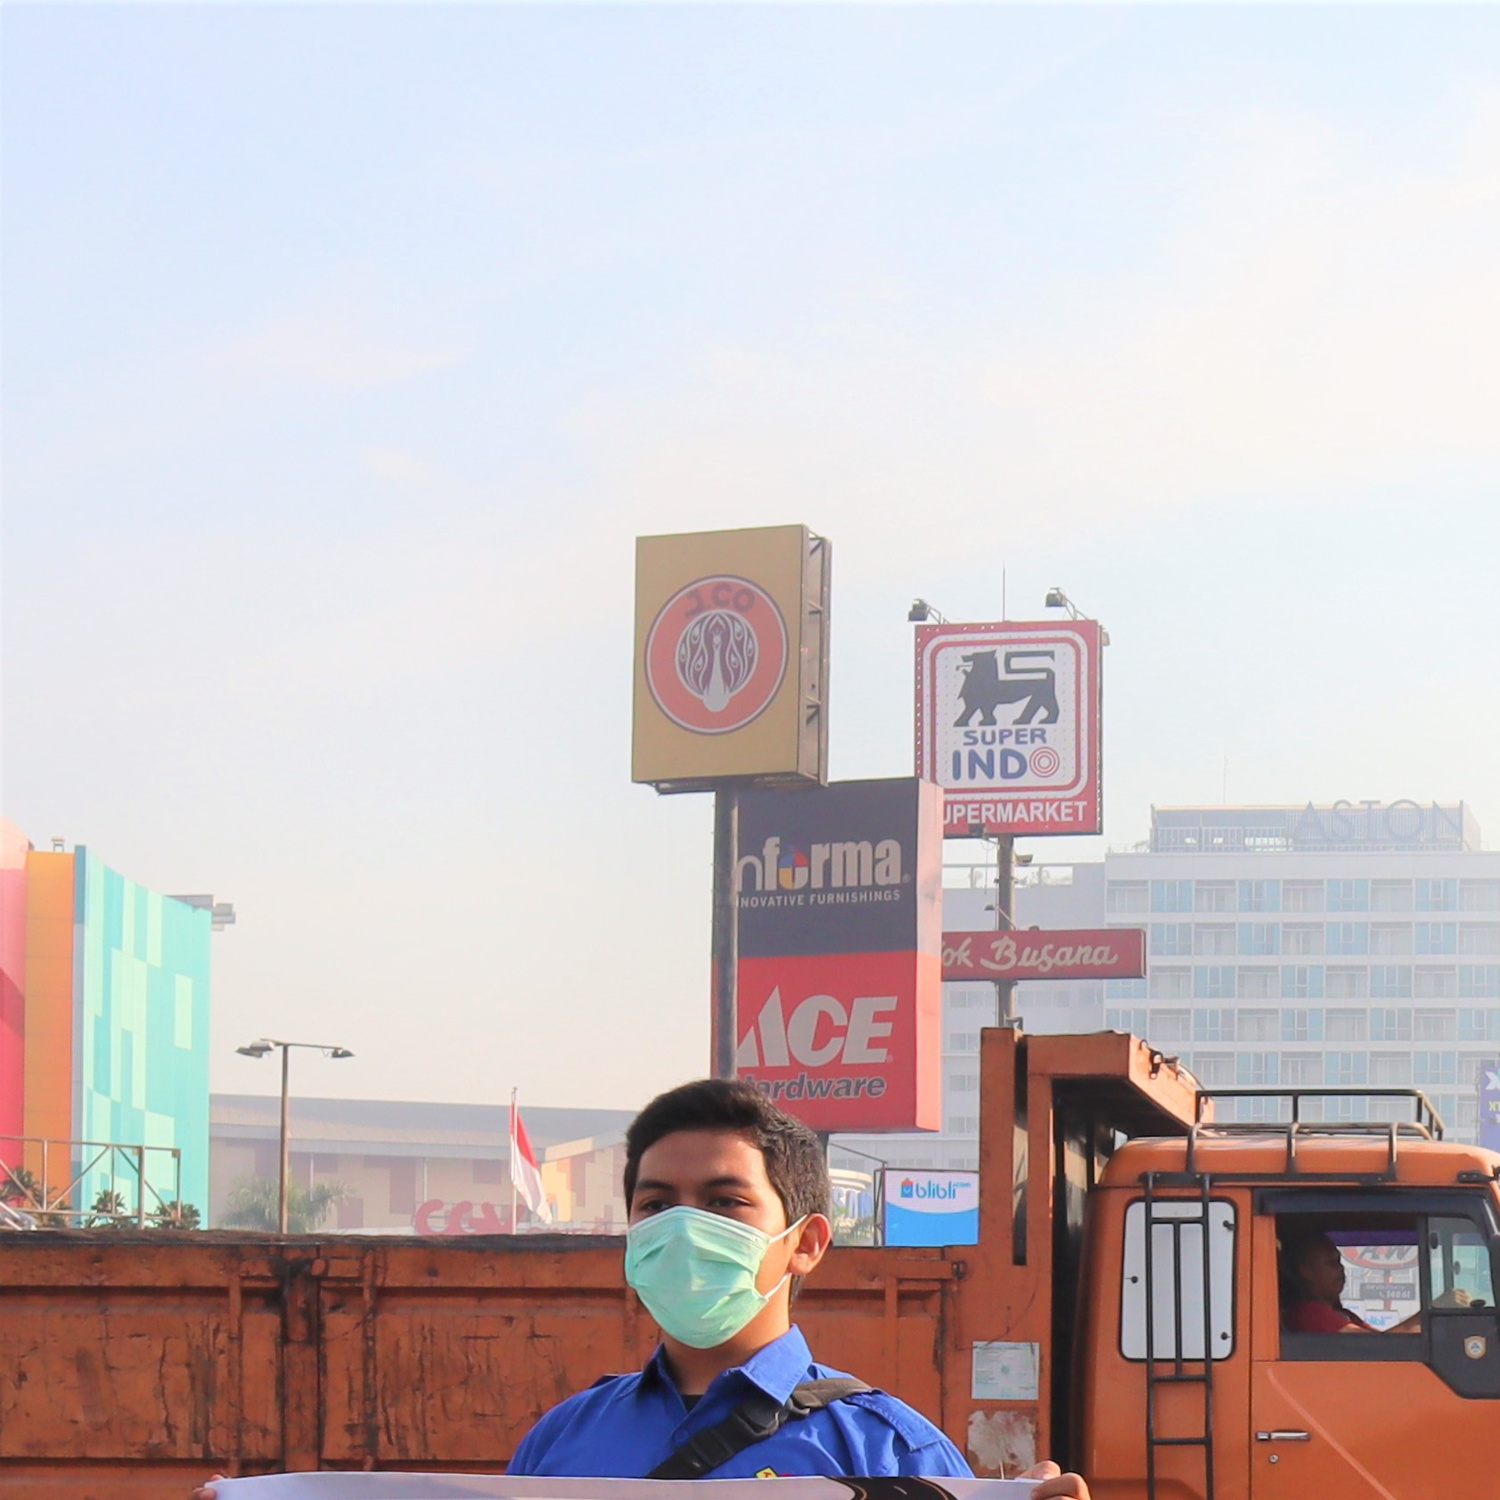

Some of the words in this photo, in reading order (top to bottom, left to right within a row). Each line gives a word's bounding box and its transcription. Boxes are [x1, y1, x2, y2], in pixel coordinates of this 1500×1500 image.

[963, 728, 1047, 746] SUPER
[952, 747, 1060, 781] INDO
[1294, 799, 1463, 840] ASTON
[737, 894, 804, 908] NOVATIVE
[810, 889, 900, 905] FURNISHINGS
[943, 937, 973, 967] ok
[737, 985, 898, 1067] ACE
[746, 1072, 888, 1100] ardware
